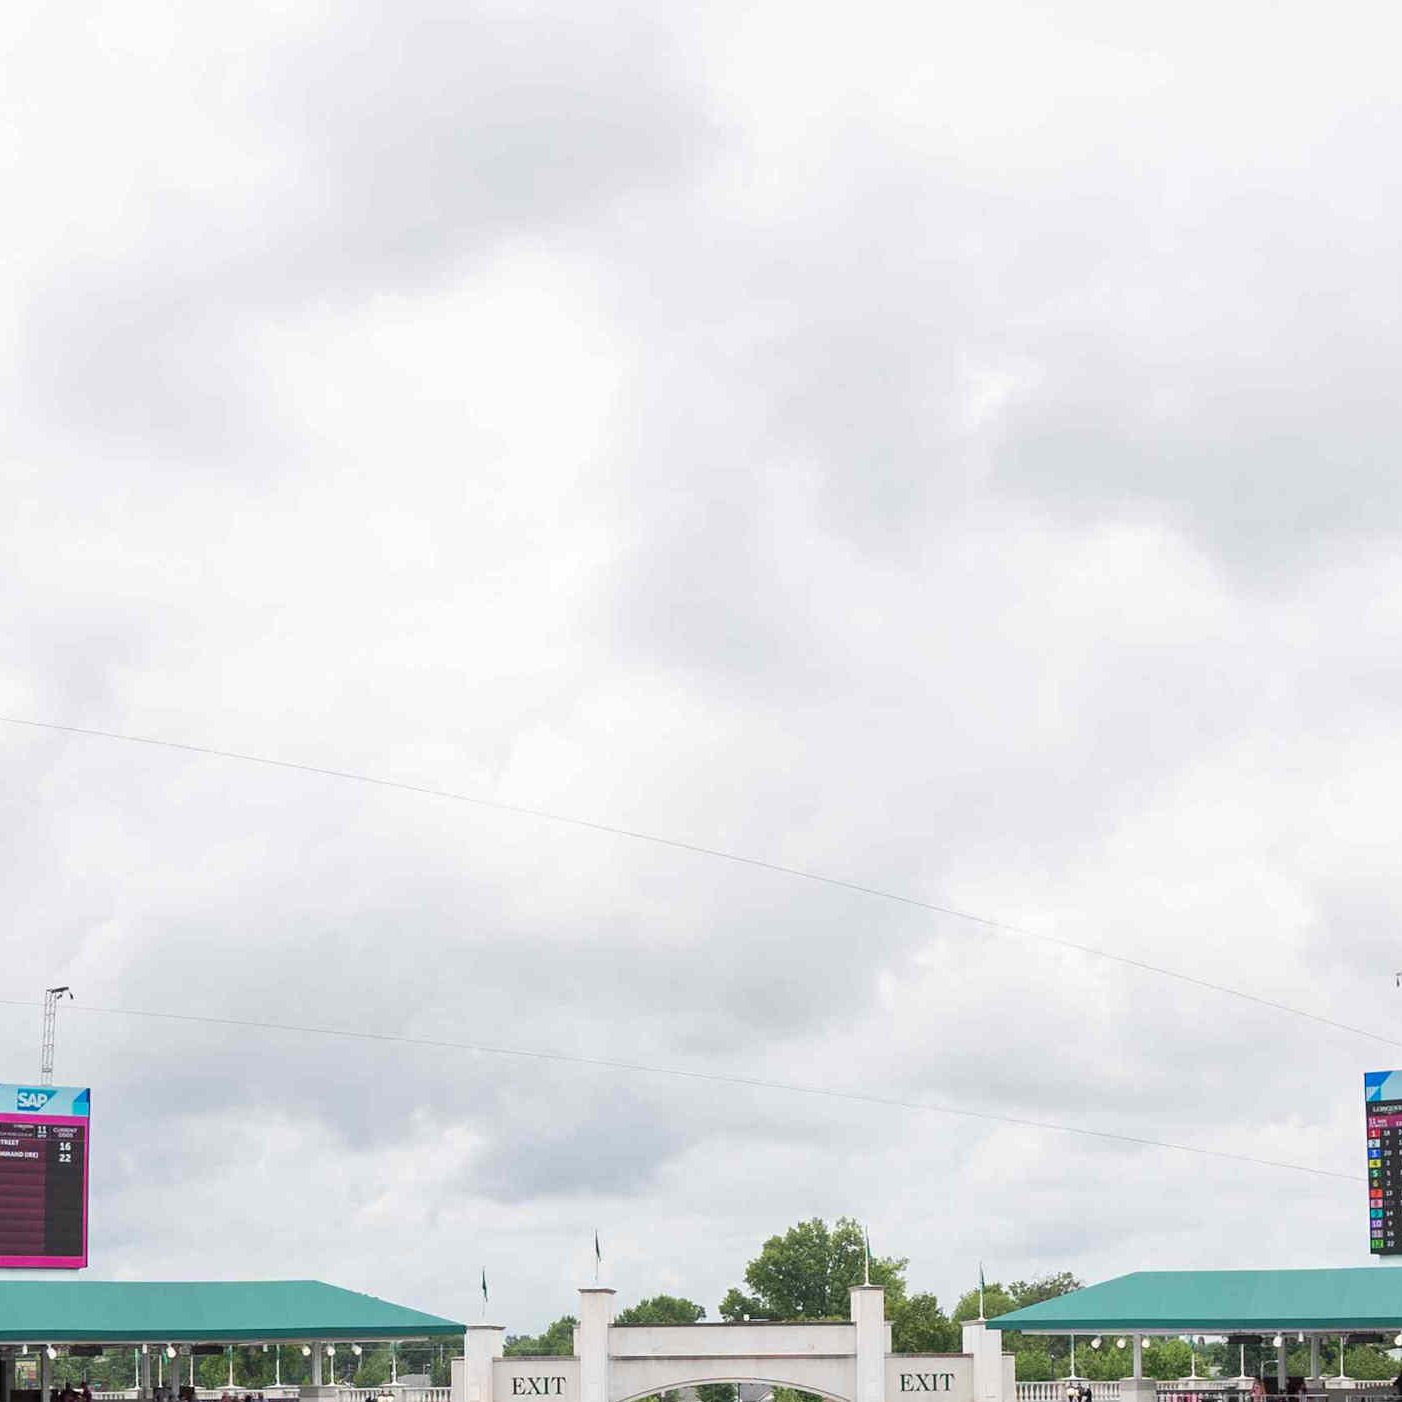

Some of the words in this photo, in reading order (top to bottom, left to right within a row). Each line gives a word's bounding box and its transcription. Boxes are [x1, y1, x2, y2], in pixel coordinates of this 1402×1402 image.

[18, 1092, 48, 1107] SAP
[37, 1126, 47, 1134] 11
[59, 1142, 71, 1151] 16
[59, 1154, 71, 1163] 22
[512, 1376, 566, 1395] EXIT
[900, 1373, 954, 1392] EXIT
